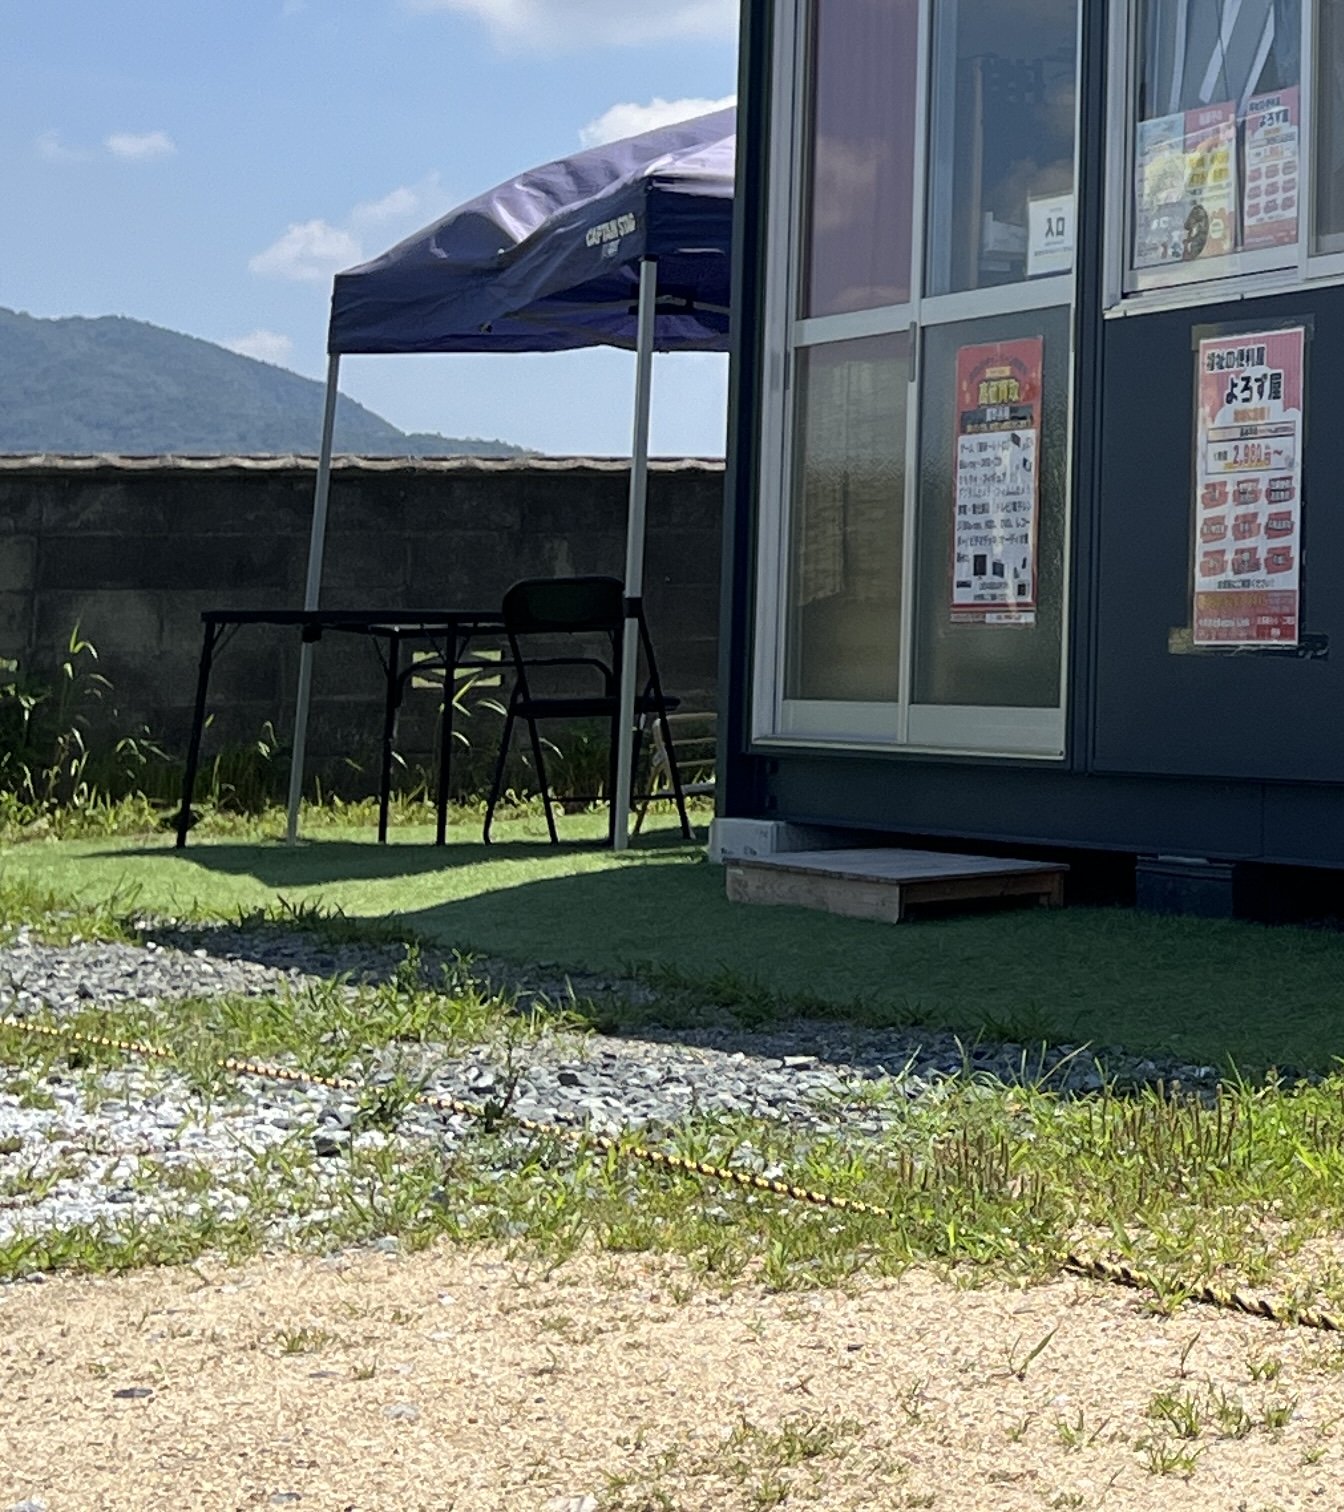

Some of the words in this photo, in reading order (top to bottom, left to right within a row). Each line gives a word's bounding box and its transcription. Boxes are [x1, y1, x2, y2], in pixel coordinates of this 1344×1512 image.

[1044, 216, 1066, 238] 入口
[1225, 372, 1283, 405] よろず屋
